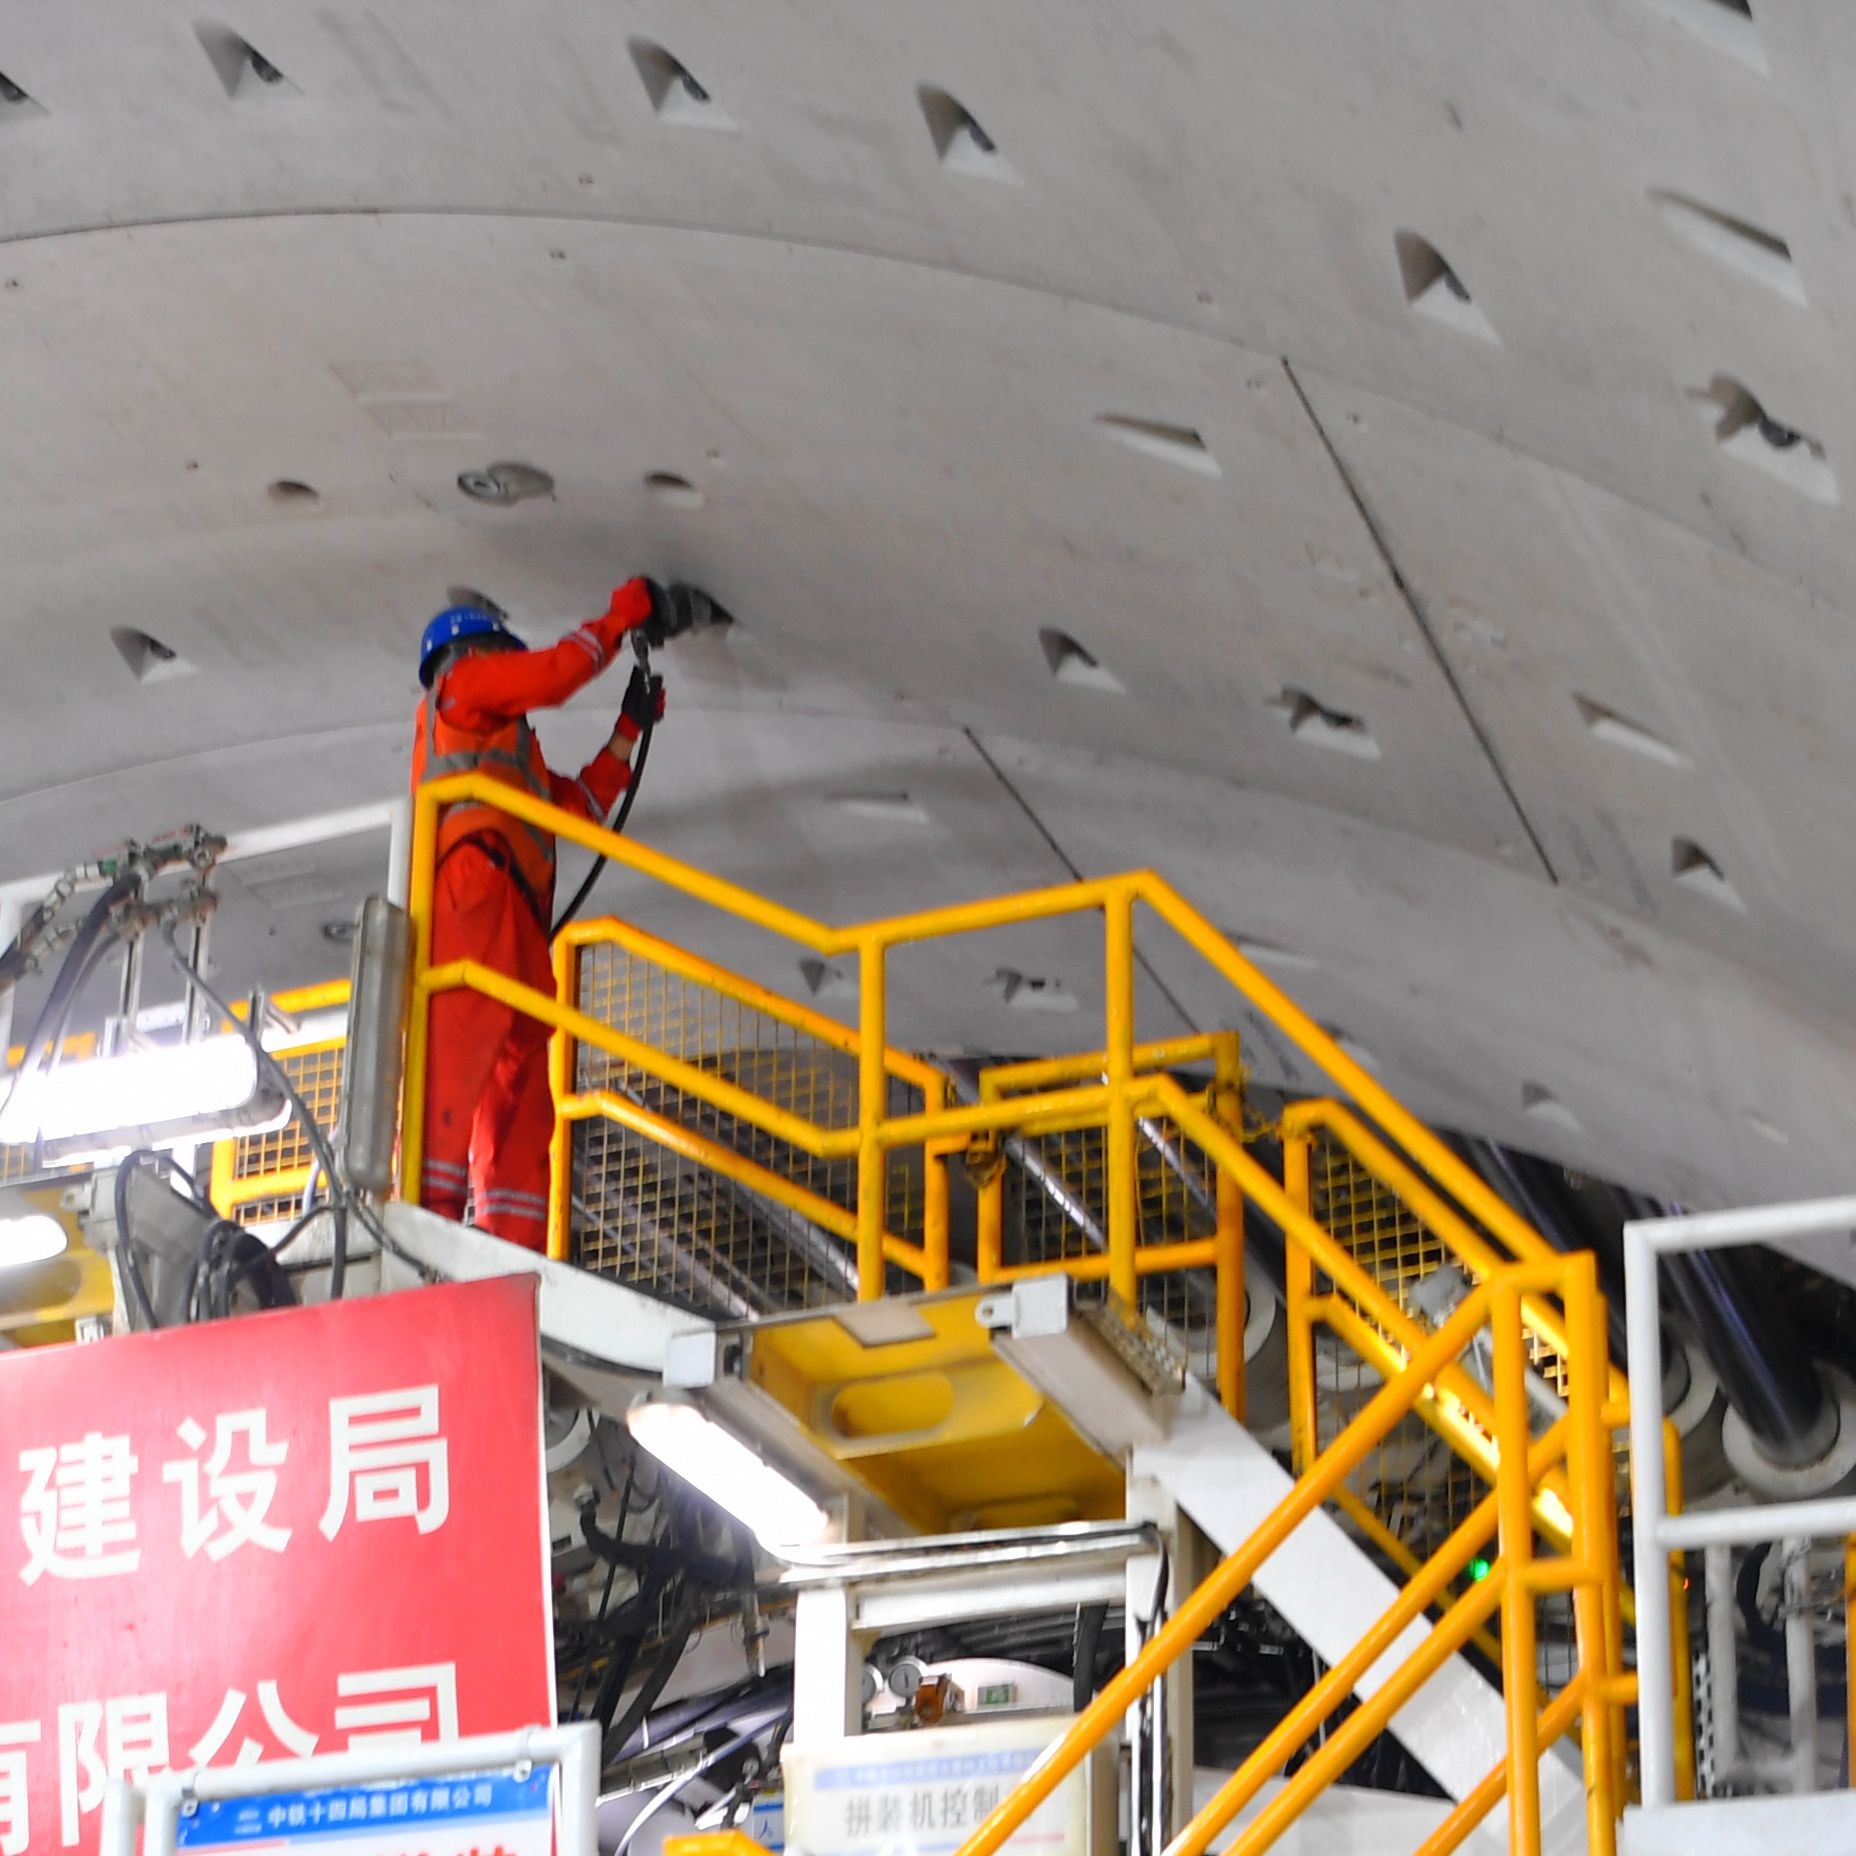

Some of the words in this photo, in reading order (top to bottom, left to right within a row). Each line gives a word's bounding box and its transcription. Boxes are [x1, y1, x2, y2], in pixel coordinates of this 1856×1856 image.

[267, 1782, 494, 1830] 中铁十四局集团有限公司
